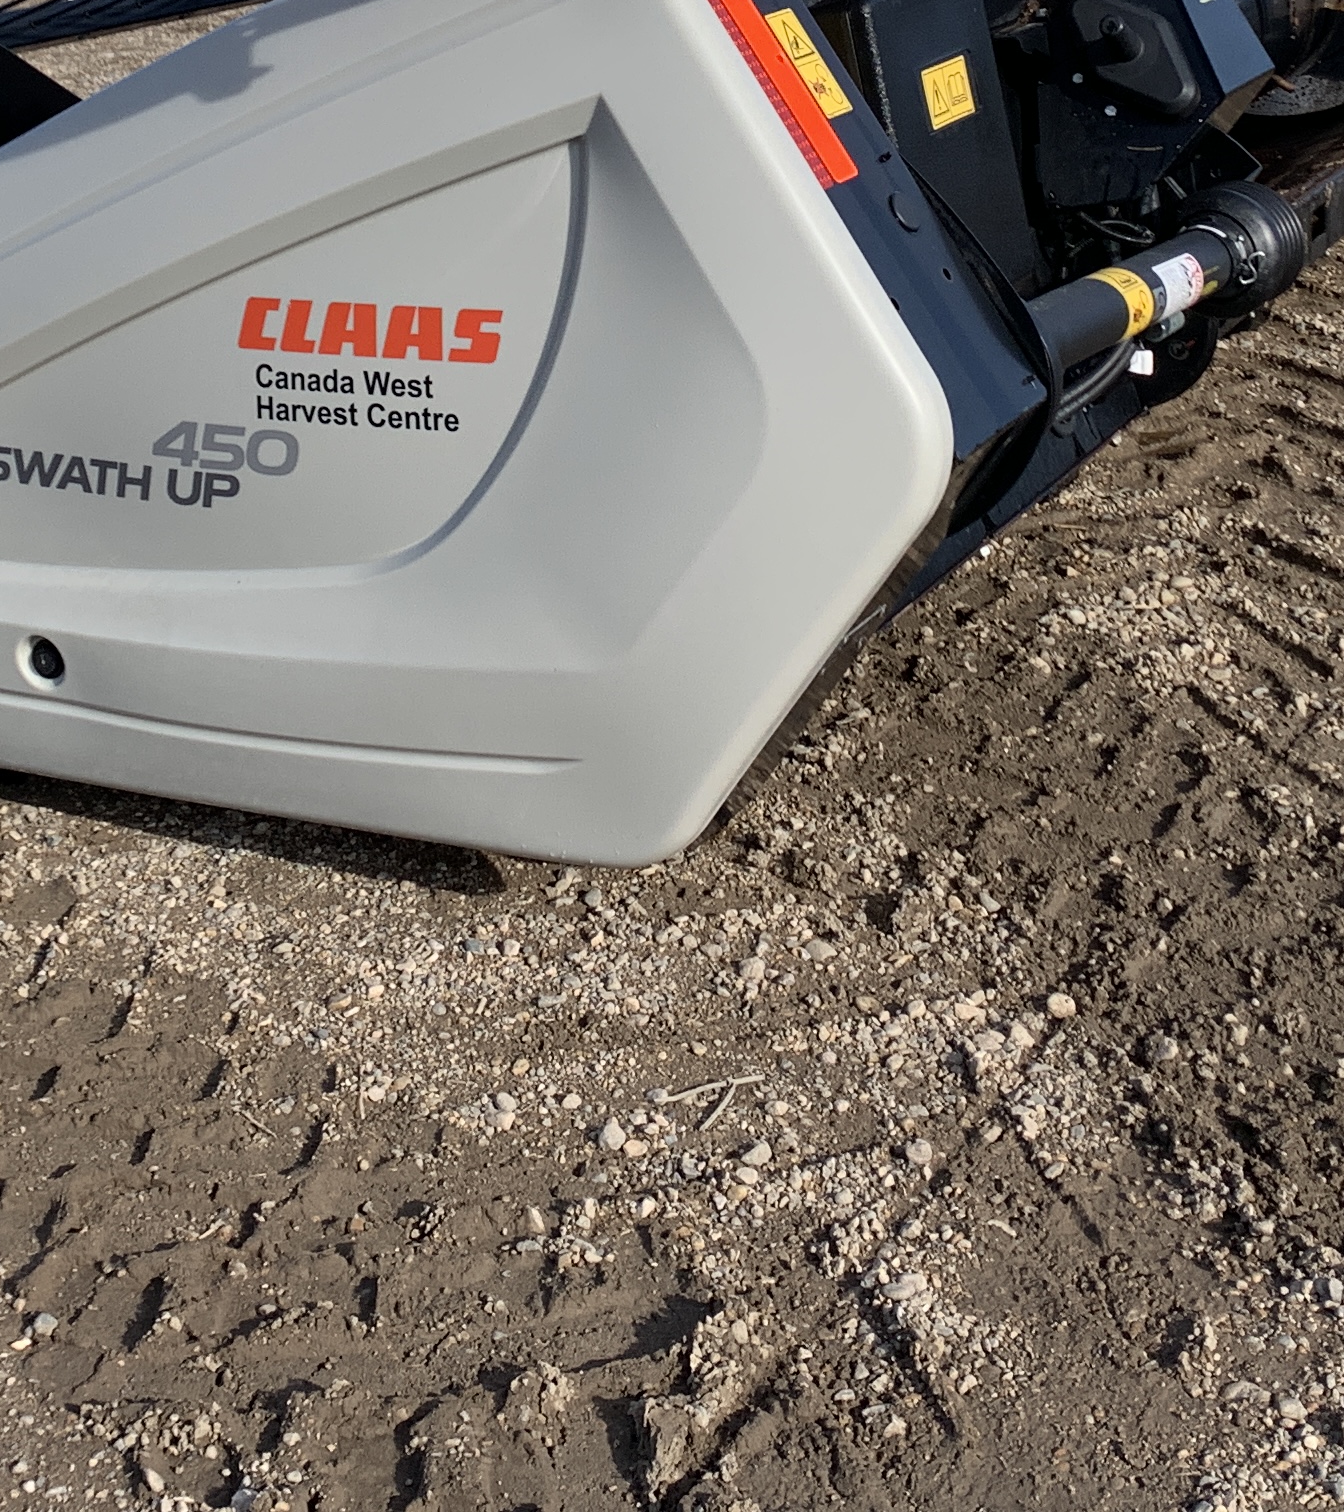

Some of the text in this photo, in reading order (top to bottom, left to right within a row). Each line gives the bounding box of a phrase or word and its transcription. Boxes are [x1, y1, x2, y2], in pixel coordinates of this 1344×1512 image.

[238, 296, 503, 364] CLAAS
[256, 363, 434, 399] Canada West
[256, 396, 460, 432] Harvest Centre
[152, 420, 299, 476] 450
[166, 468, 241, 508] UP
